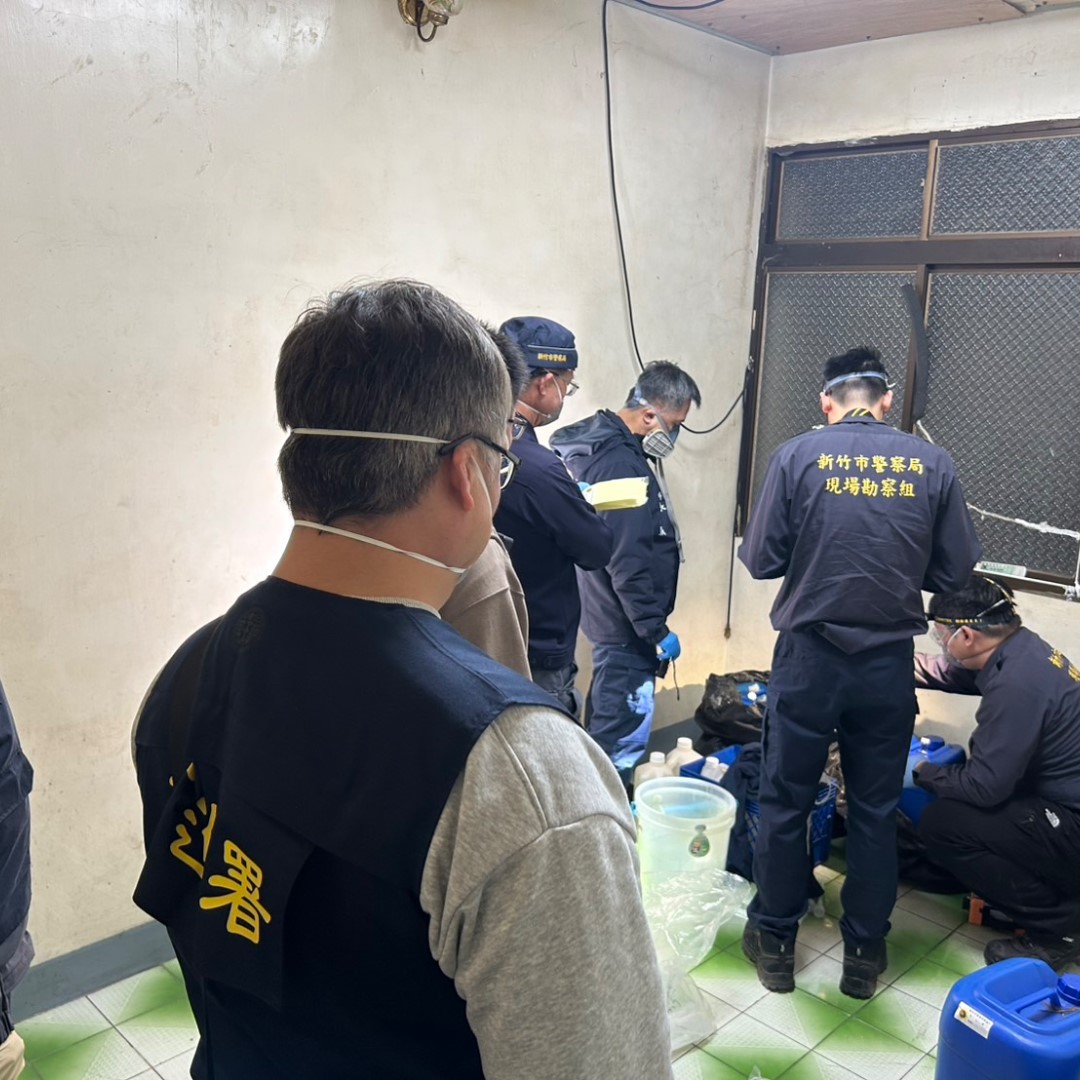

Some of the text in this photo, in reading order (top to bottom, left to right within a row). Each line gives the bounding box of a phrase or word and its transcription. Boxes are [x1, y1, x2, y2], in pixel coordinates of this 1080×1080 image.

[817, 453, 924, 474] 新竹市警察局
[825, 477, 915, 497] 現場勘察組
